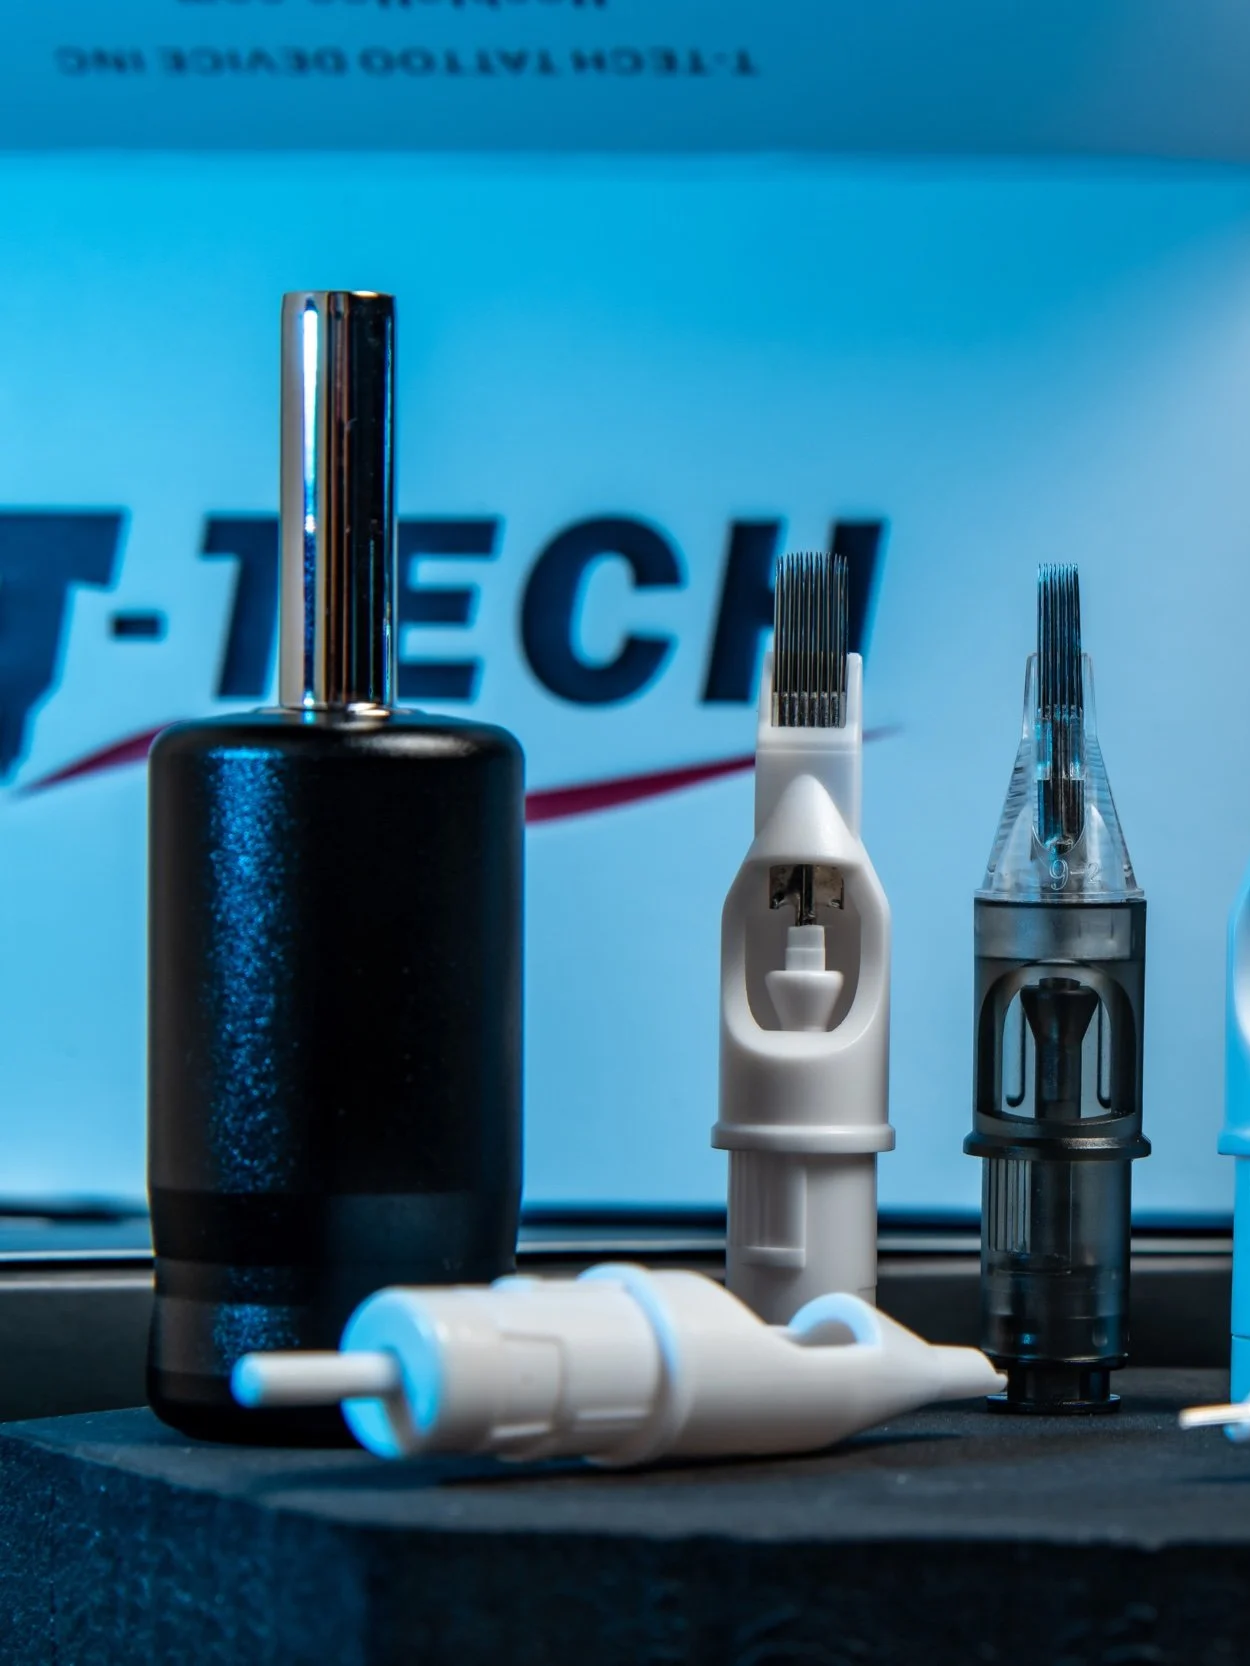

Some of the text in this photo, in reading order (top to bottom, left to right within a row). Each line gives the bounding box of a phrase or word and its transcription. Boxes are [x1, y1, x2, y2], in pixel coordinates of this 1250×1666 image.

[54, 45, 762, 79] T-TECH TATTOO DEVICE INC
